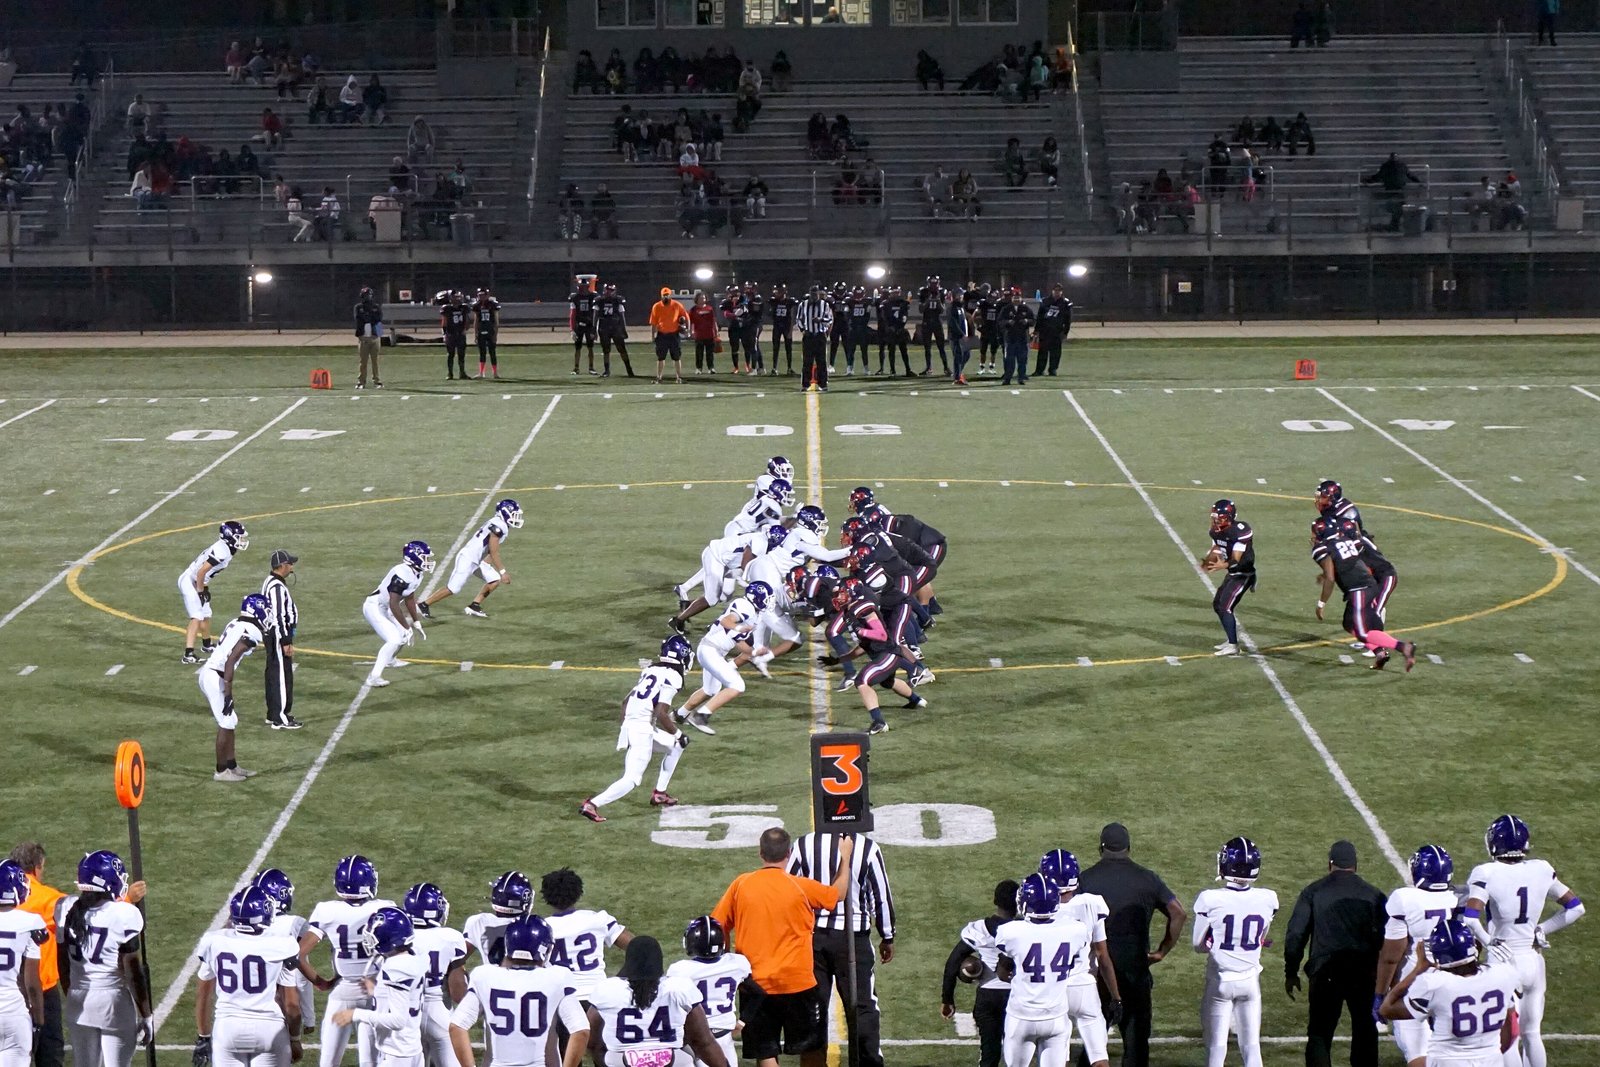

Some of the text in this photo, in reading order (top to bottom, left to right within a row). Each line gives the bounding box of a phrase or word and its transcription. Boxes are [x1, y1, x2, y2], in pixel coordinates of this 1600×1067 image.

[820, 744, 863, 795] 3
[1514, 886, 1528, 924] 1
[549, 932, 600, 972] 42
[1219, 914, 1264, 951] 10
[216, 951, 267, 994] 60
[1022, 942, 1075, 983] 44
[489, 988, 549, 1038] 50
[697, 976, 737, 1016] 13
[1451, 989, 1506, 1038] 62
[615, 1006, 678, 1044] 64
